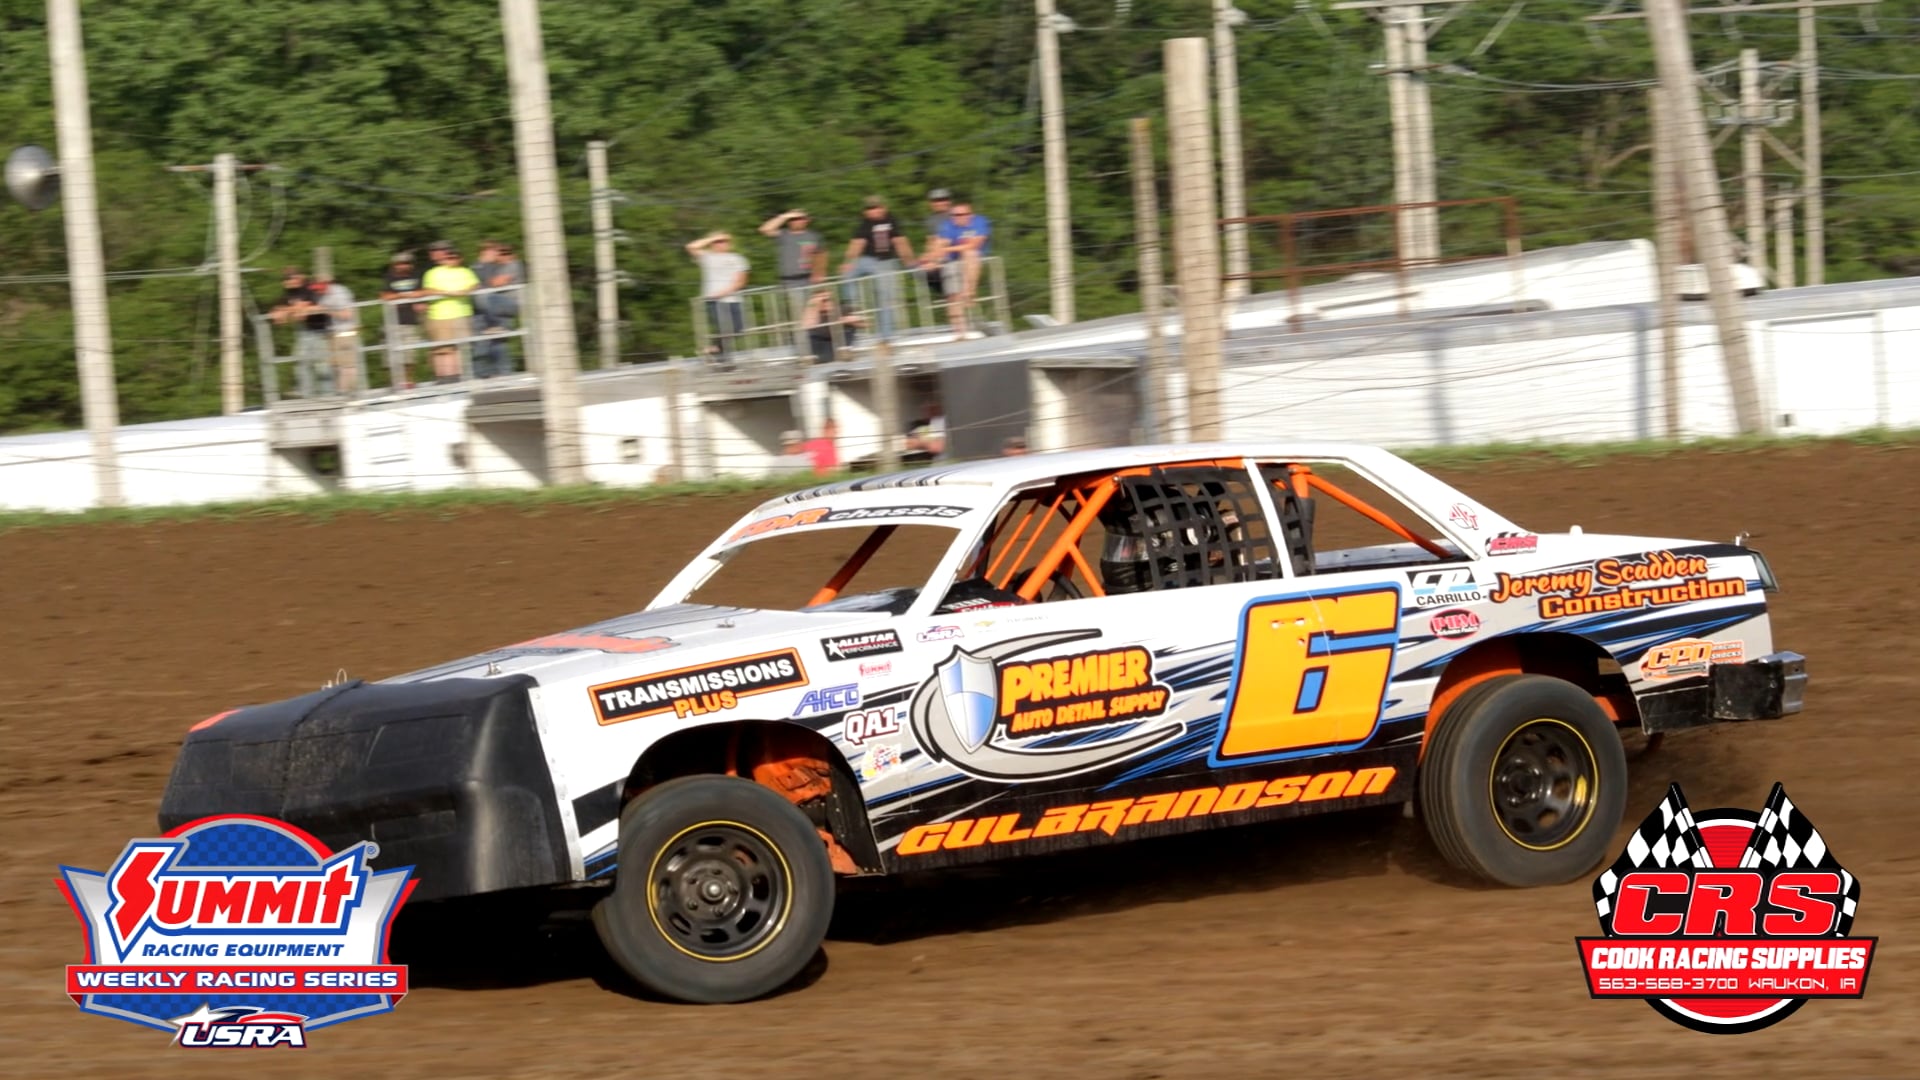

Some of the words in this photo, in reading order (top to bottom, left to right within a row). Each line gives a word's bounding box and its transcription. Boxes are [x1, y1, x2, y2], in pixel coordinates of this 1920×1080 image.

[828, 506, 964, 521] chassis
[1490, 568, 1592, 603] Jeremy
[1597, 551, 1707, 586] Scadden
[1540, 577, 1746, 619] Construction
[1416, 591, 1481, 606] CARRILLO
[838, 632, 895, 648] ALLSTAR
[599, 659, 795, 711] TRANSMISSIONS
[1001, 650, 1149, 717] PREMIER
[1219, 588, 1398, 758] 6
[674, 691, 738, 719] PLUS
[792, 682, 860, 717] AFCO
[1011, 708, 1054, 732] AUTO
[1055, 700, 1107, 725] DETAIL
[1109, 690, 1165, 716] SUPPLY
[845, 706, 900, 746] QA1
[896, 766, 1396, 855] GULBRANDSON
